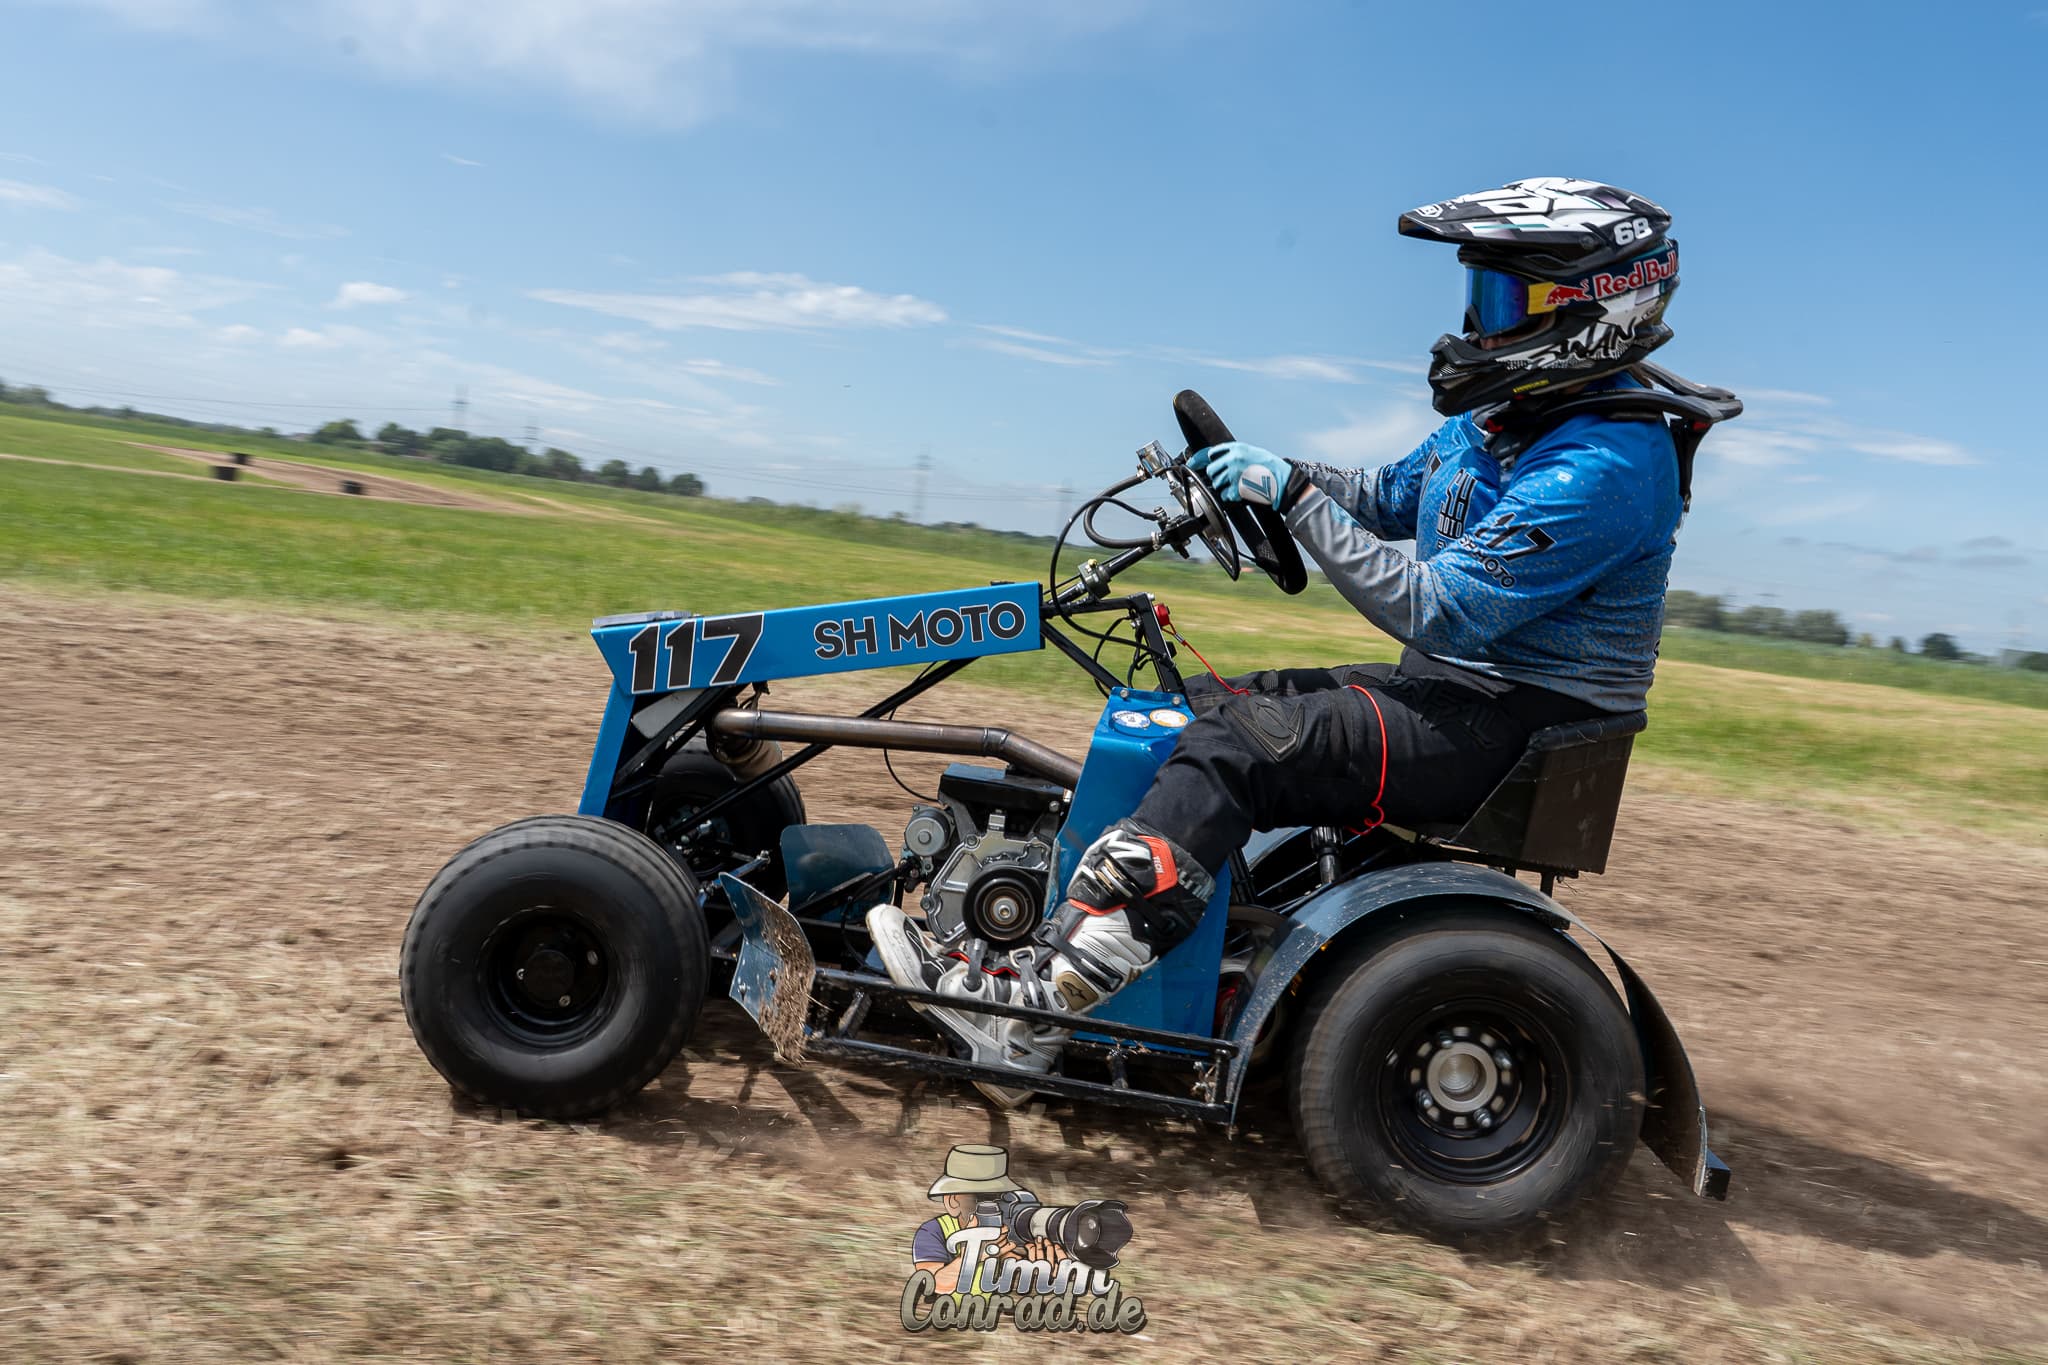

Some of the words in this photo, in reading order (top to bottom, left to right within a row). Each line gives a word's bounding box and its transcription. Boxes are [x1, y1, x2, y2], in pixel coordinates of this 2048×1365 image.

[1613, 217, 1653, 245] 68
[1593, 262, 1645, 299] Red
[1644, 251, 1677, 283] Bull
[629, 613, 765, 694] 117
[813, 616, 878, 660] SH
[888, 601, 1026, 652] MOTO
